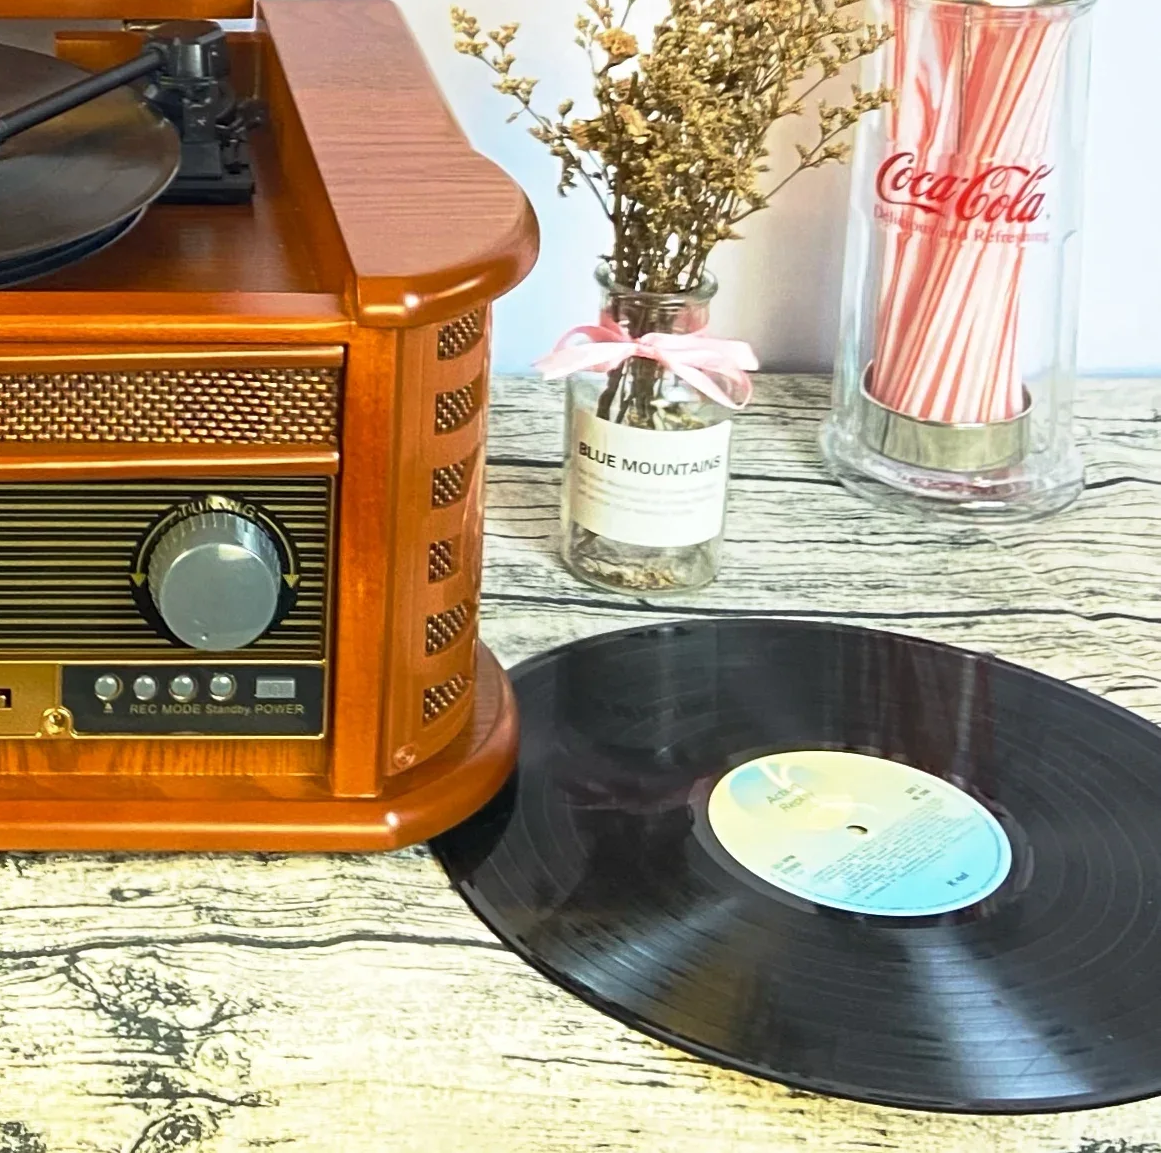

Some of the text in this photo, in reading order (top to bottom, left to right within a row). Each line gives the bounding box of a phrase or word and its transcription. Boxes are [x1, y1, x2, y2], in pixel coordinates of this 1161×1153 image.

[578, 441, 721, 476] BLUE MOUNTAINS
[130, 704, 157, 715] REC
[162, 704, 200, 715] MODE
[205, 704, 250, 717] Standby
[254, 704, 304, 715] POWER
